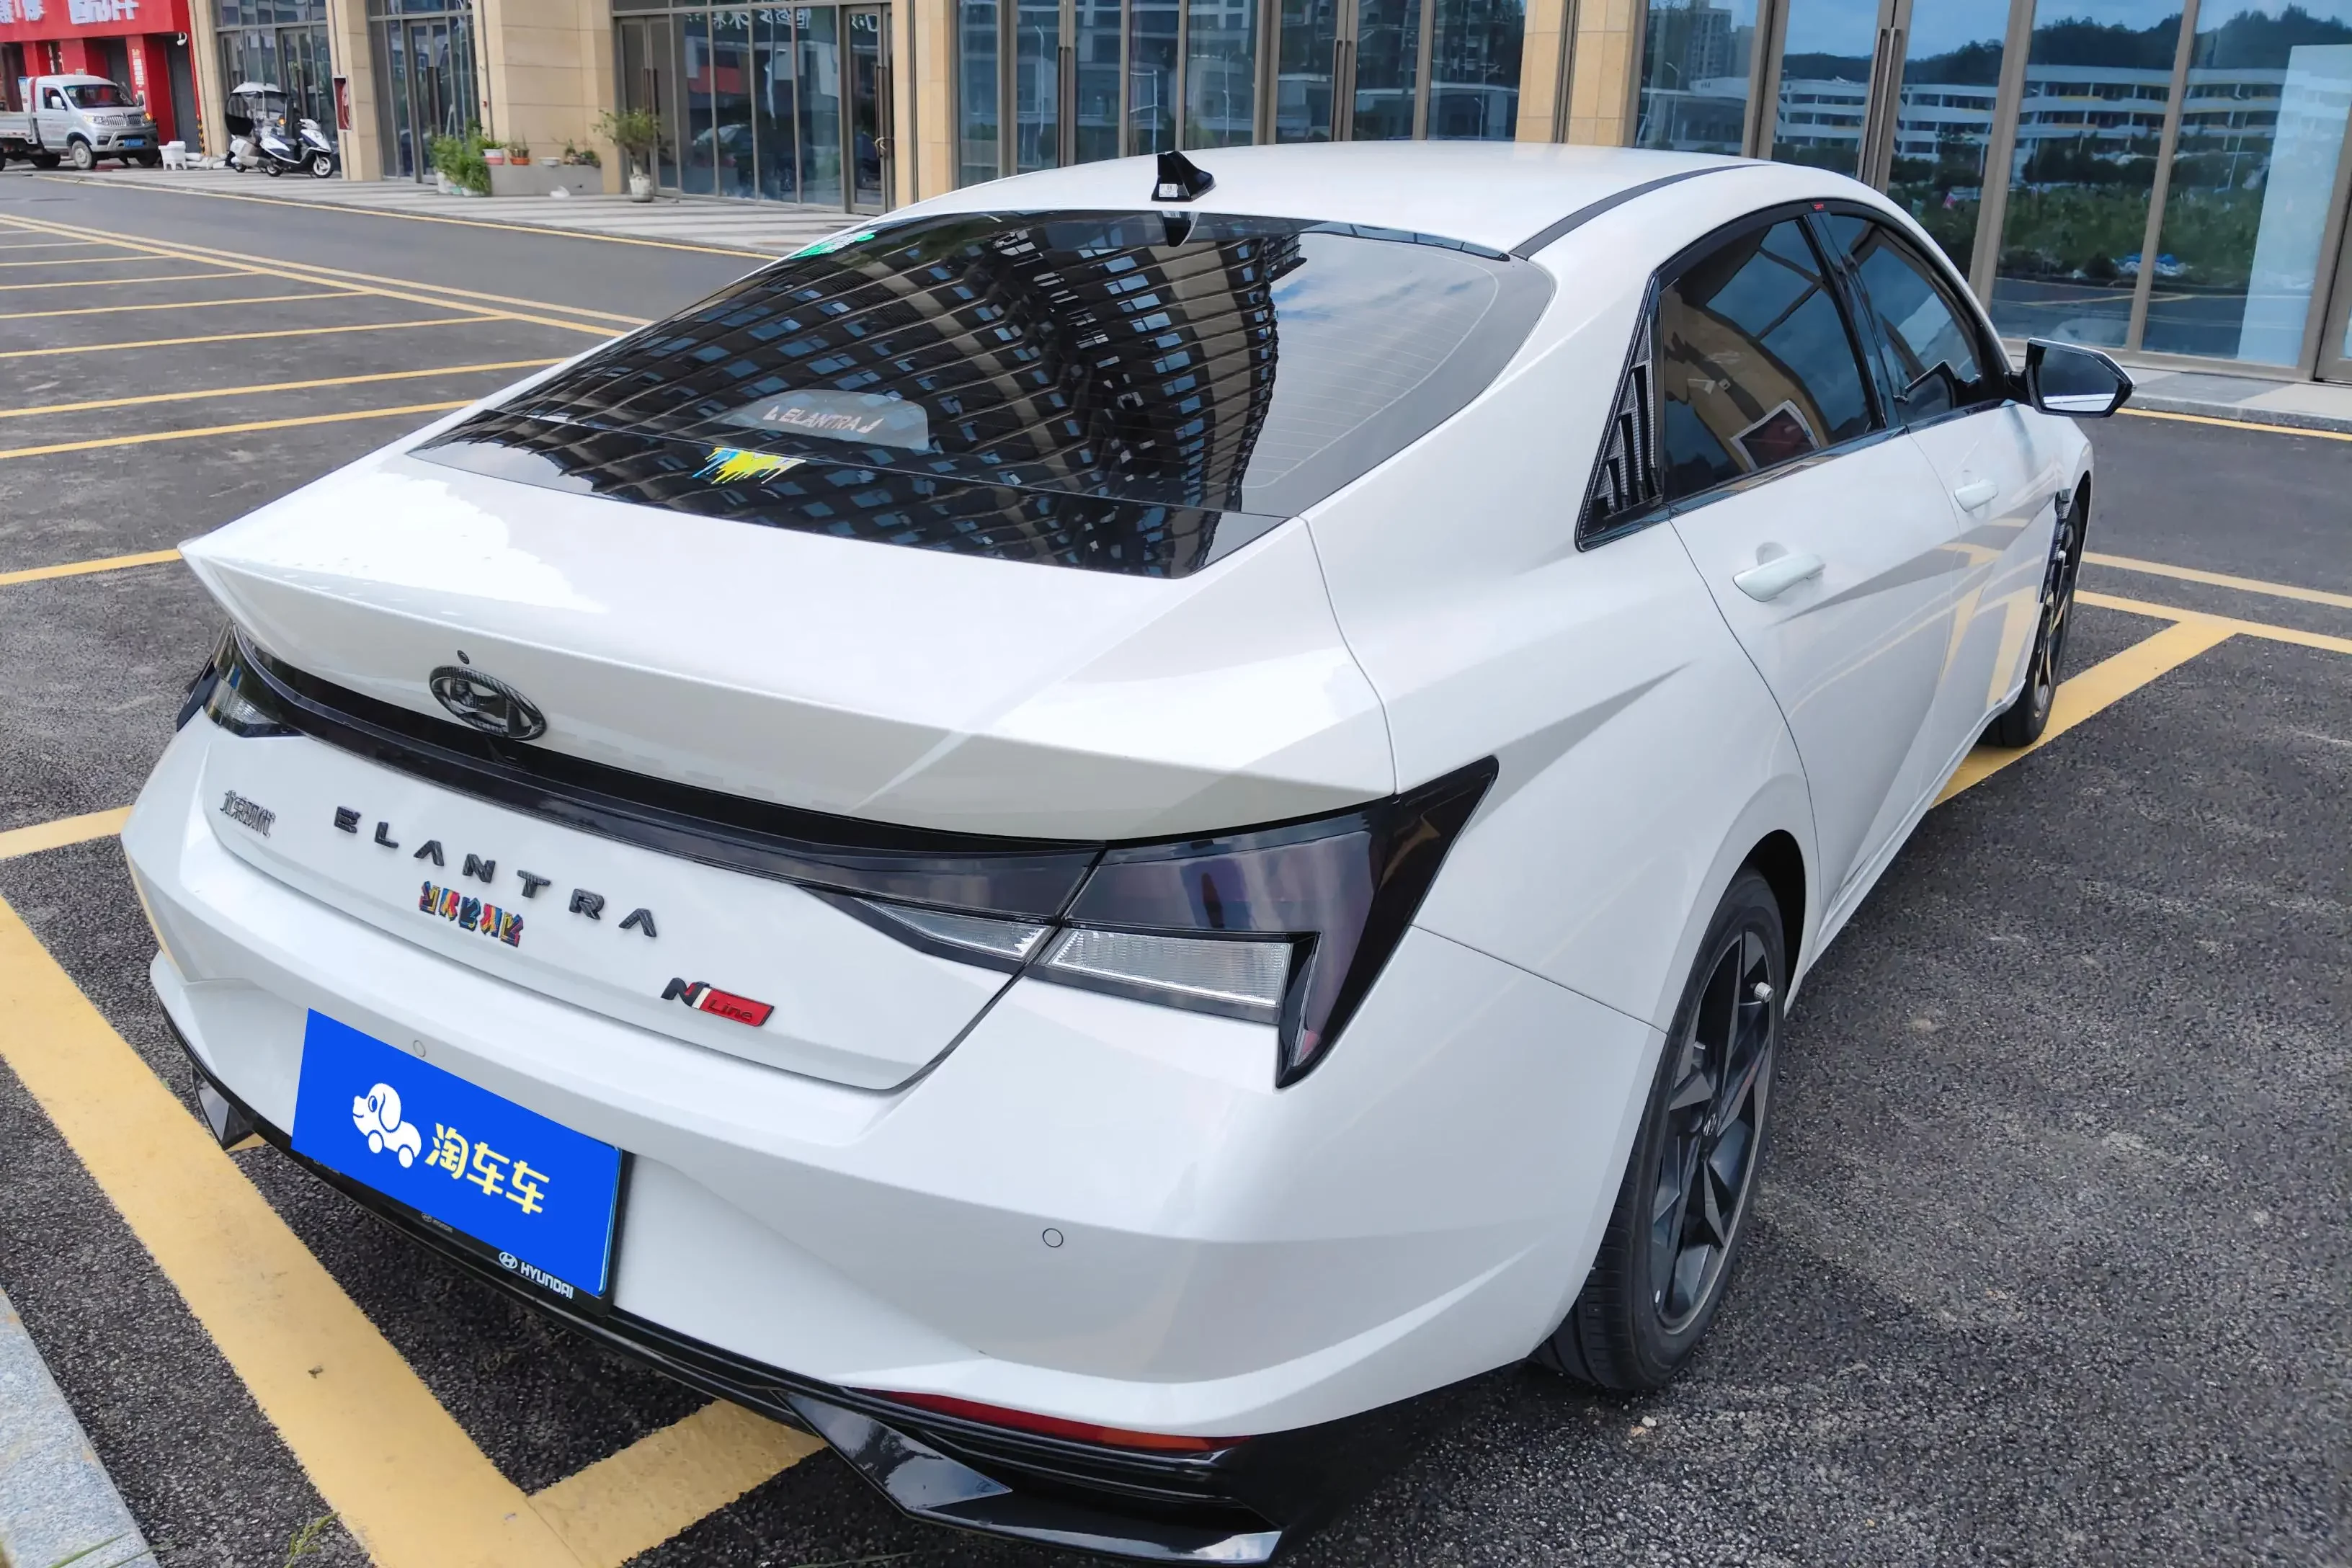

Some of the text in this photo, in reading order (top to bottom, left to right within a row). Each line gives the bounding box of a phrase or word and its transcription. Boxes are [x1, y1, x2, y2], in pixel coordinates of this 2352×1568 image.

[779, 409, 861, 430] ELANTRA
[220, 790, 276, 838] 北京现代
[334, 806, 657, 937] ELANTRA
[661, 977, 753, 1023] N Line
[521, 1261, 574, 1299] HYUNDAI
